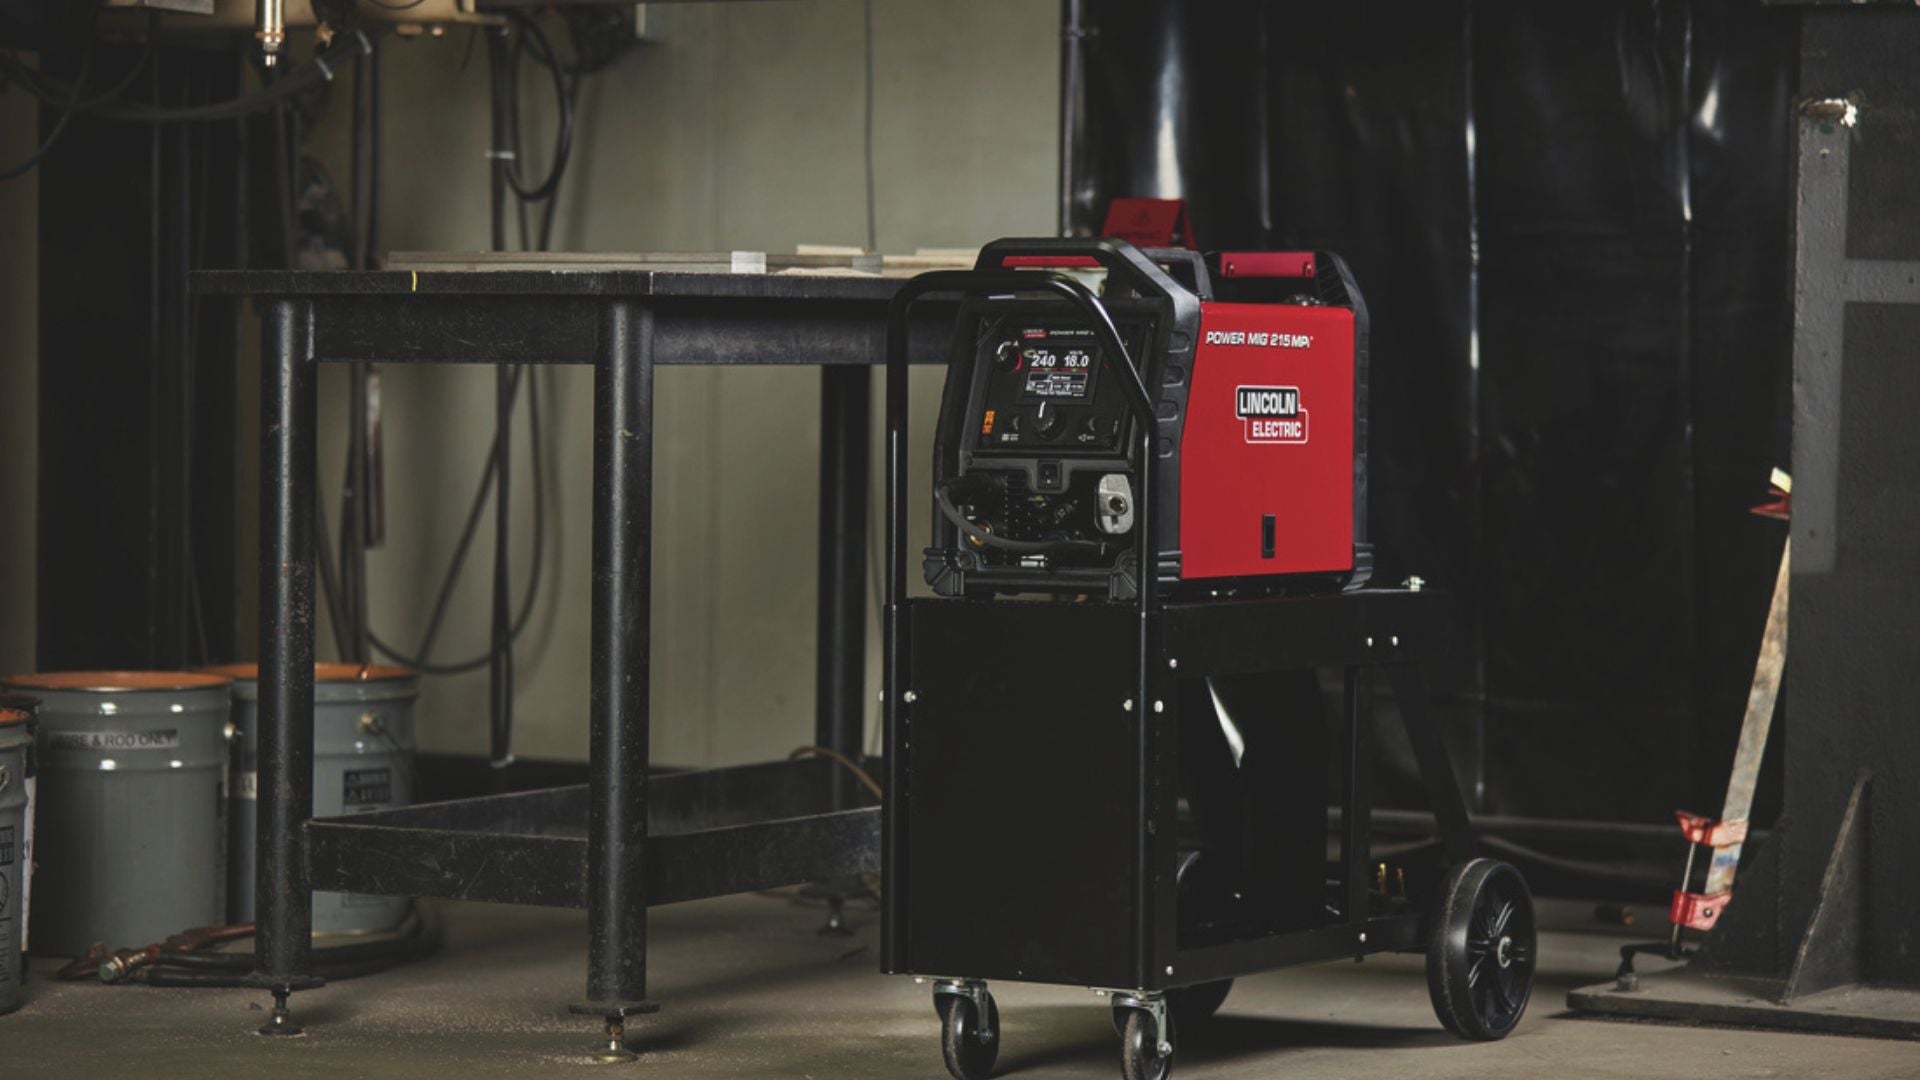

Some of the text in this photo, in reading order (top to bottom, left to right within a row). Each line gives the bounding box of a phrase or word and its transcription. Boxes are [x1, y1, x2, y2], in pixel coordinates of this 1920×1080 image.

[1205, 331, 1245, 345] POWER
[1247, 332, 1268, 346] MIG
[1270, 334, 1291, 347] 215
[1031, 355, 1089, 367] 240 18.0
[1239, 391, 1296, 414] LINCOLN
[1252, 421, 1301, 437] ELECTRIC
